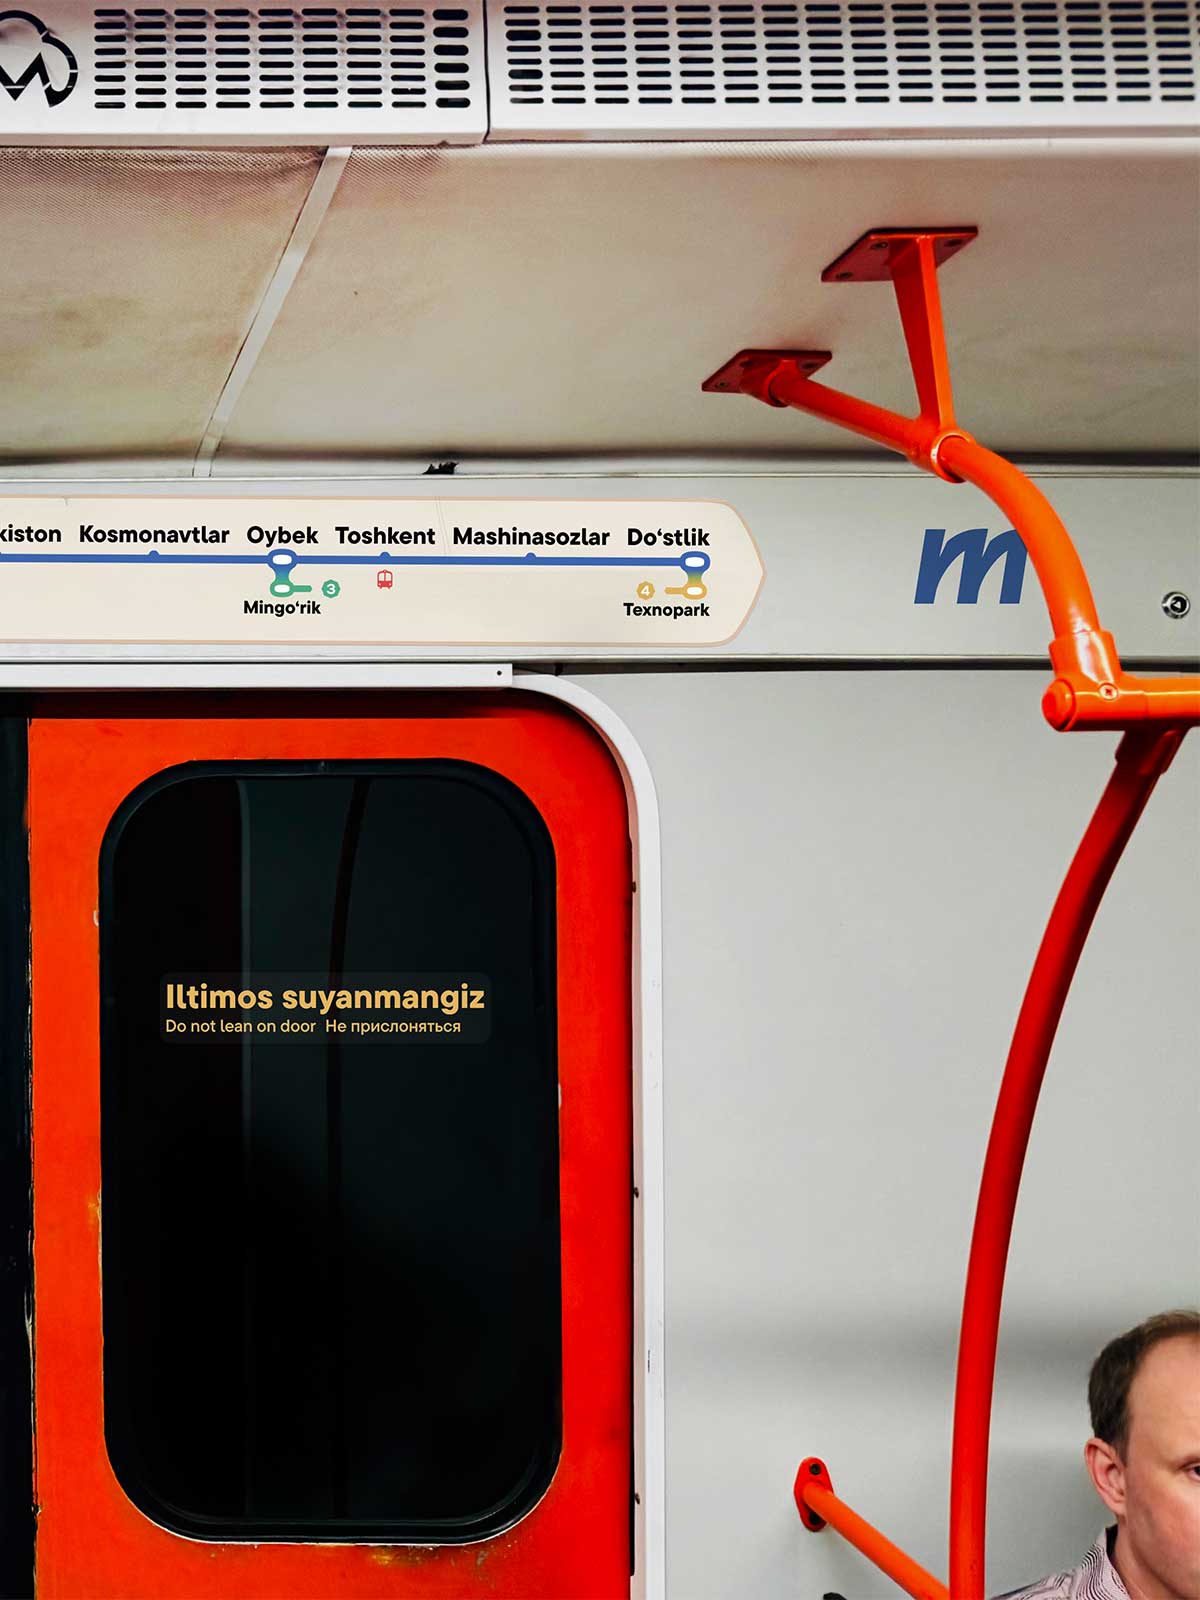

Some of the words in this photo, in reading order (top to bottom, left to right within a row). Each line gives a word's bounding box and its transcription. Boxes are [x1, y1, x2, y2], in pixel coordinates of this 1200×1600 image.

[80, 525, 230, 544] Kosmonavtlar
[247, 526, 319, 548] Oybek
[335, 527, 436, 545] Toshkent
[453, 527, 611, 546] Mashinasozlar
[628, 528, 710, 547] Do‘stlik
[243, 600, 321, 618] Mingo‘rik
[623, 603, 710, 620] Texnopark
[166, 983, 273, 1010] Iltimos
[282, 983, 485, 1016] suyanmangiz
[165, 1019, 187, 1033] Do
[190, 1020, 215, 1033] not
[220, 1019, 253, 1033] lean
[256, 1022, 276, 1033] on
[280, 1019, 317, 1033] door
[325, 1019, 347, 1033] Не
[351, 1022, 461, 1035] прислоняться
